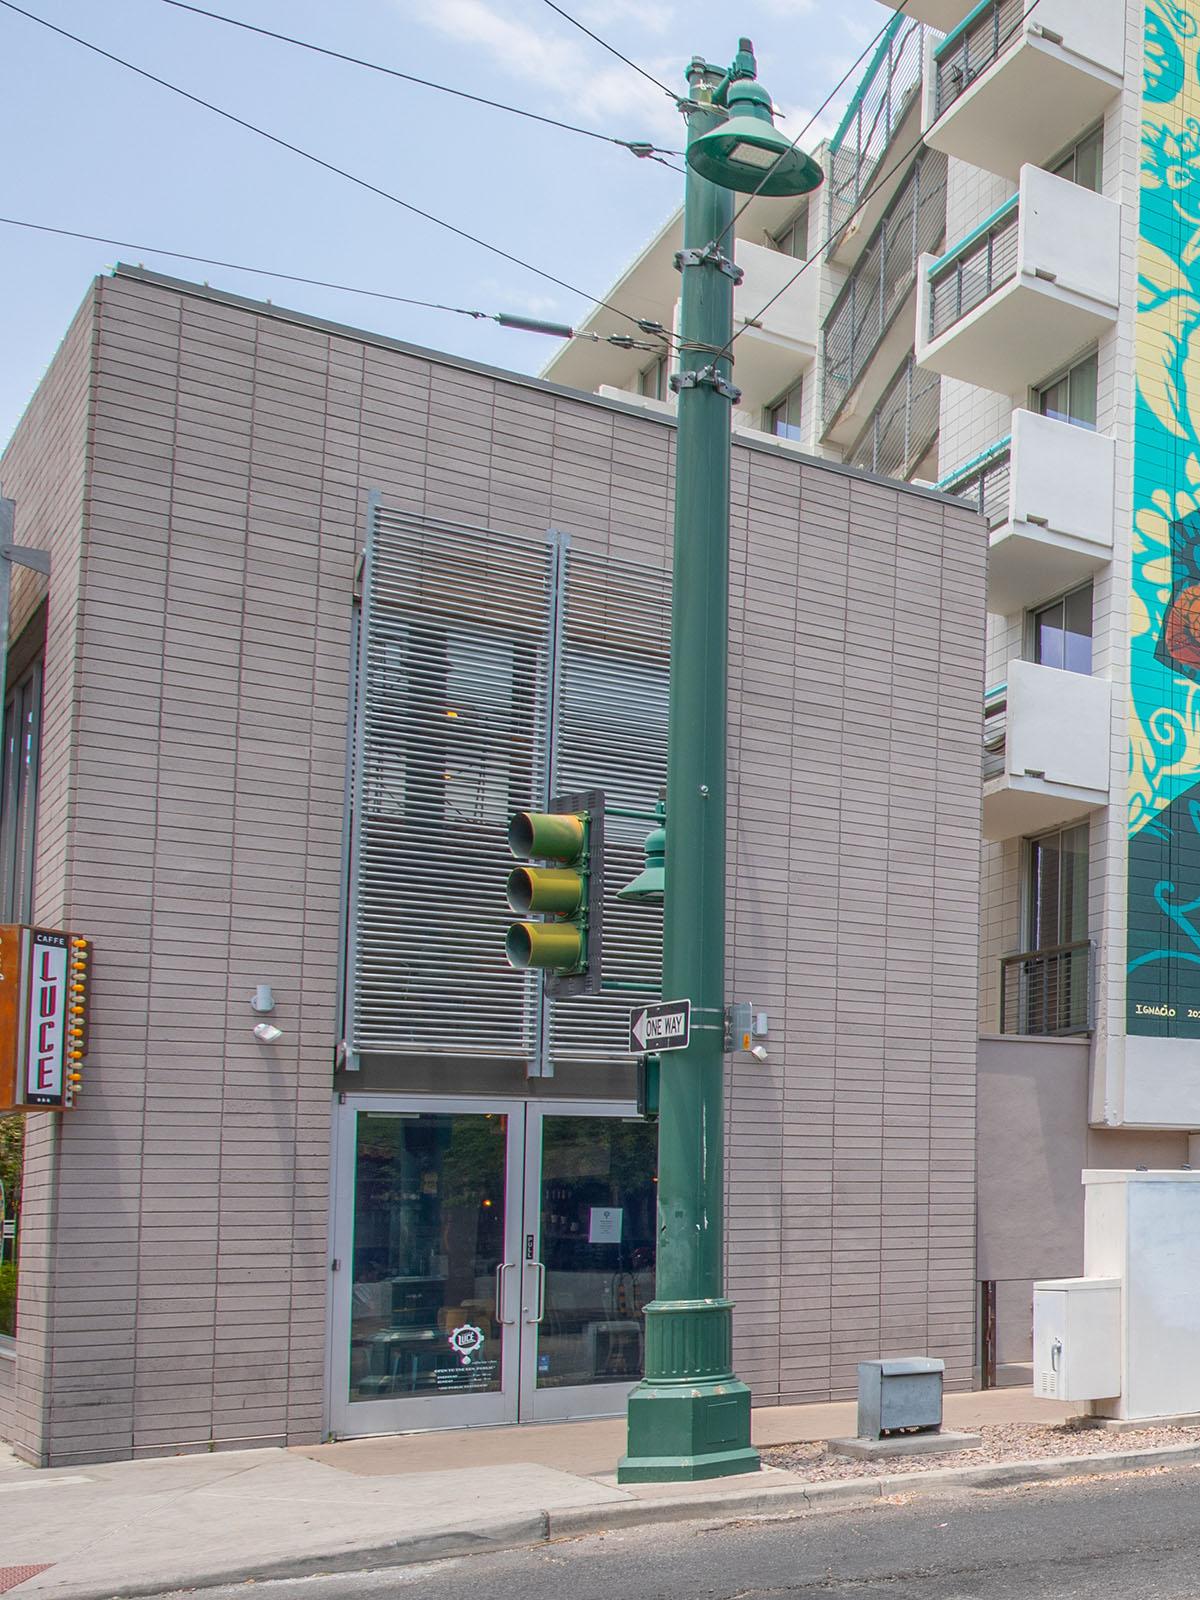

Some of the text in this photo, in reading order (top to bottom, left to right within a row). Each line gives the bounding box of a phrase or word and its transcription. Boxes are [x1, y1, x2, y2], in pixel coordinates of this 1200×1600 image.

[37, 934, 65, 945] CAFFE
[37, 951, 57, 1090] LUCE
[647, 1016, 682, 1036] ONE WAY
[458, 1331, 476, 1346] LUCE
